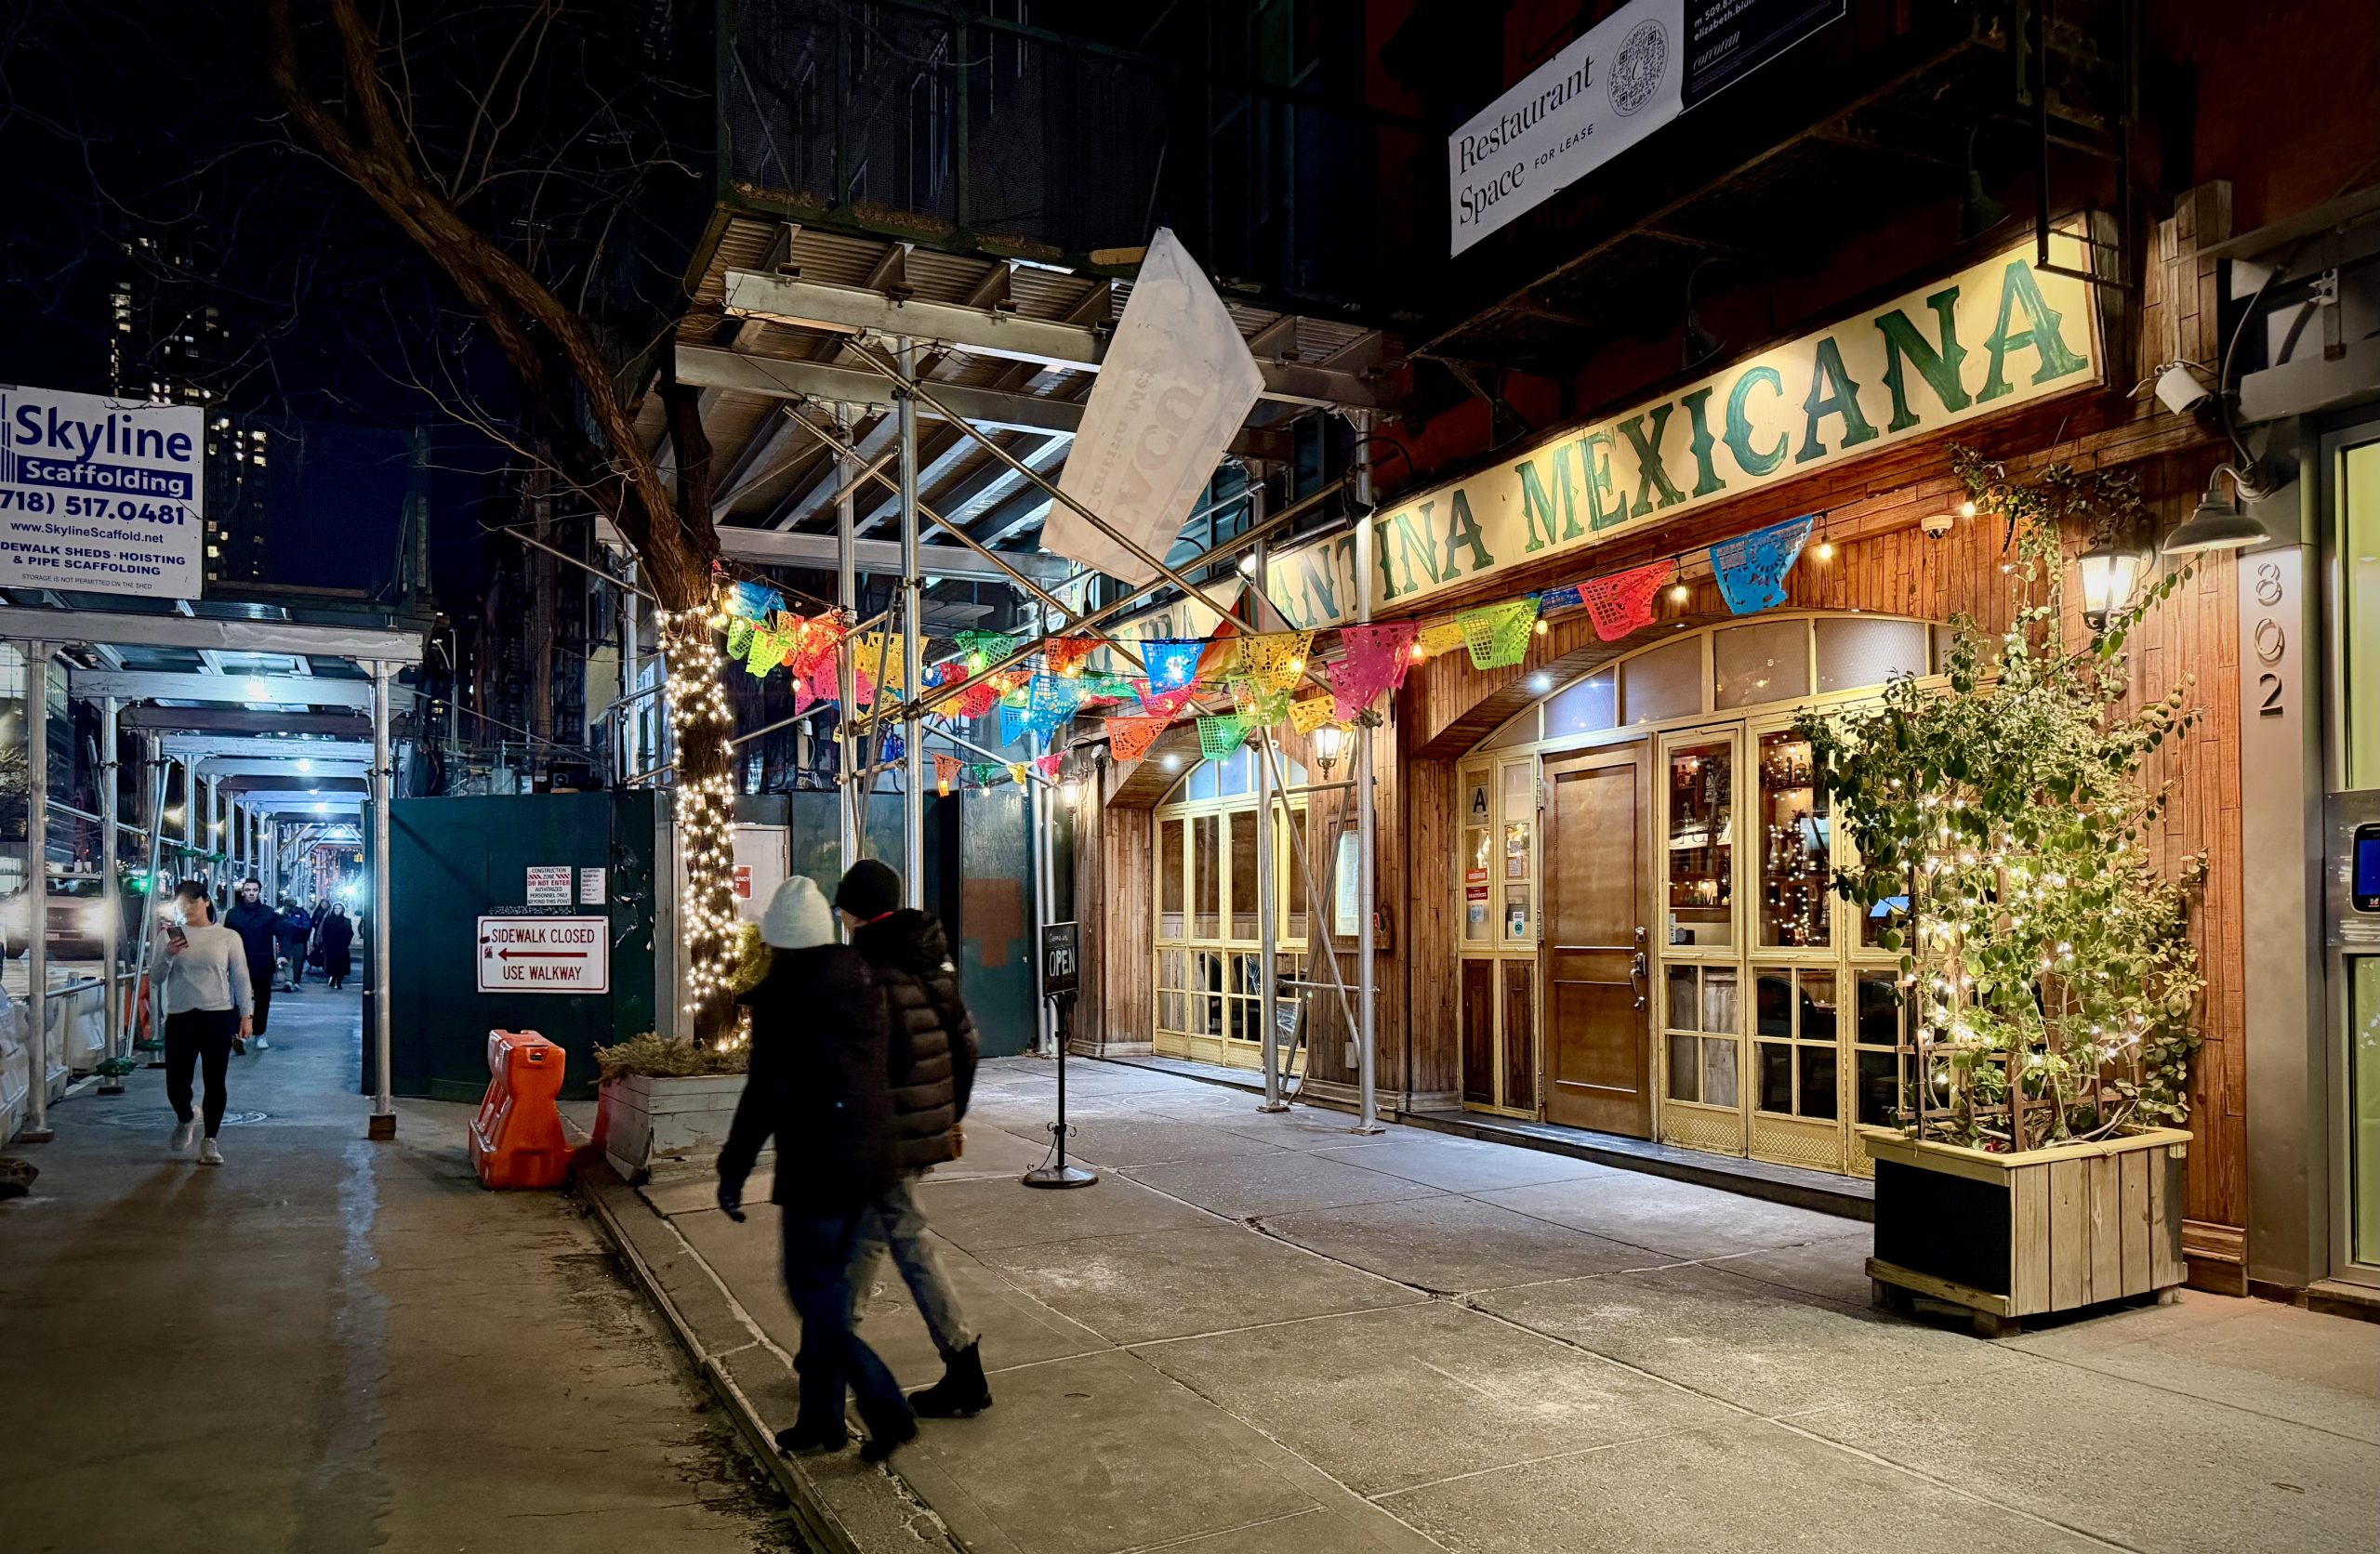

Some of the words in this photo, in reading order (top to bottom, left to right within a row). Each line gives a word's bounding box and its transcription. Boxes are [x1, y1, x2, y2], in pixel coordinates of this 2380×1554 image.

[1460, 55, 1594, 176] Restaurant
[1460, 161, 1525, 226] Space
[1534, 148, 1555, 170] FOR
[1559, 123, 1594, 153] LEASE
[1515, 258, 2089, 553] MEXICANA
[16, 404, 192, 463] Skyline
[26, 460, 184, 497] Scaffolding
[65, 495, 184, 525] 517.0481
[10, 522, 164, 544] www.SkylineScaffold.net
[13, 555, 23, 564] &
[28, 556, 60, 567] PIPE
[64, 560, 161, 575] SCAFFOLDING
[65, 547, 111, 560] SHEDS
[119, 551, 186, 565] HOISTING
[21, 573, 51, 582] STORAGE
[74, 577, 111, 586] PERMITTED
[1473, 787, 1487, 813] A
[491, 928, 546, 943] SIDEWALK
[550, 928, 595, 943] CLOSED
[503, 966, 524, 981] USE
[529, 966, 582, 981] WALKWAY
[1049, 947, 1076, 977] OPEN
